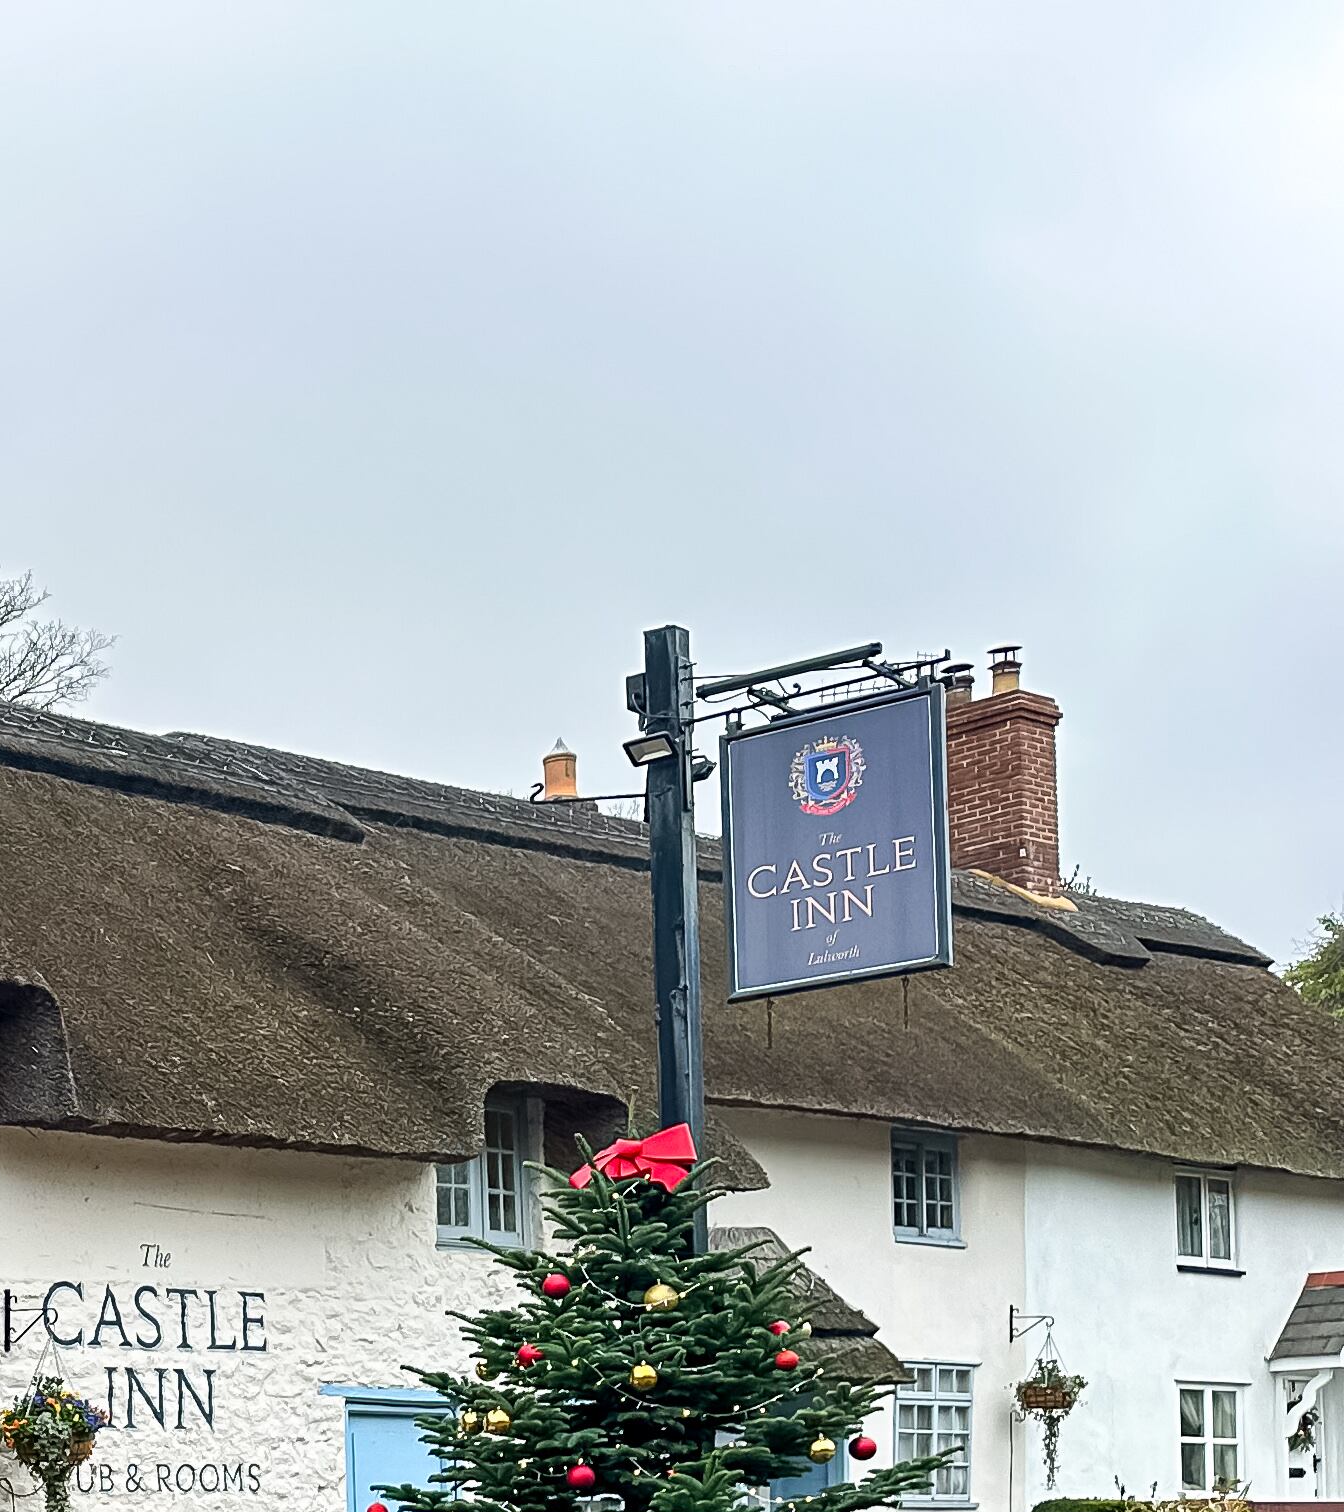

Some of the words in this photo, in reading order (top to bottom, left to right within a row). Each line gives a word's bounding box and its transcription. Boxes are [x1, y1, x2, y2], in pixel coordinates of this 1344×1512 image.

[819, 832, 842, 847] The
[746, 836, 918, 899] CASTLE
[789, 884, 874, 932] INN
[825, 928, 840, 947] of
[140, 1243, 171, 1268] The
[43, 1281, 267, 1352] CASTLE
[103, 1366, 217, 1431] INN
[70, 1463, 114, 1493] UB
[126, 1464, 146, 1492] &
[156, 1463, 261, 1493] ROOMS
